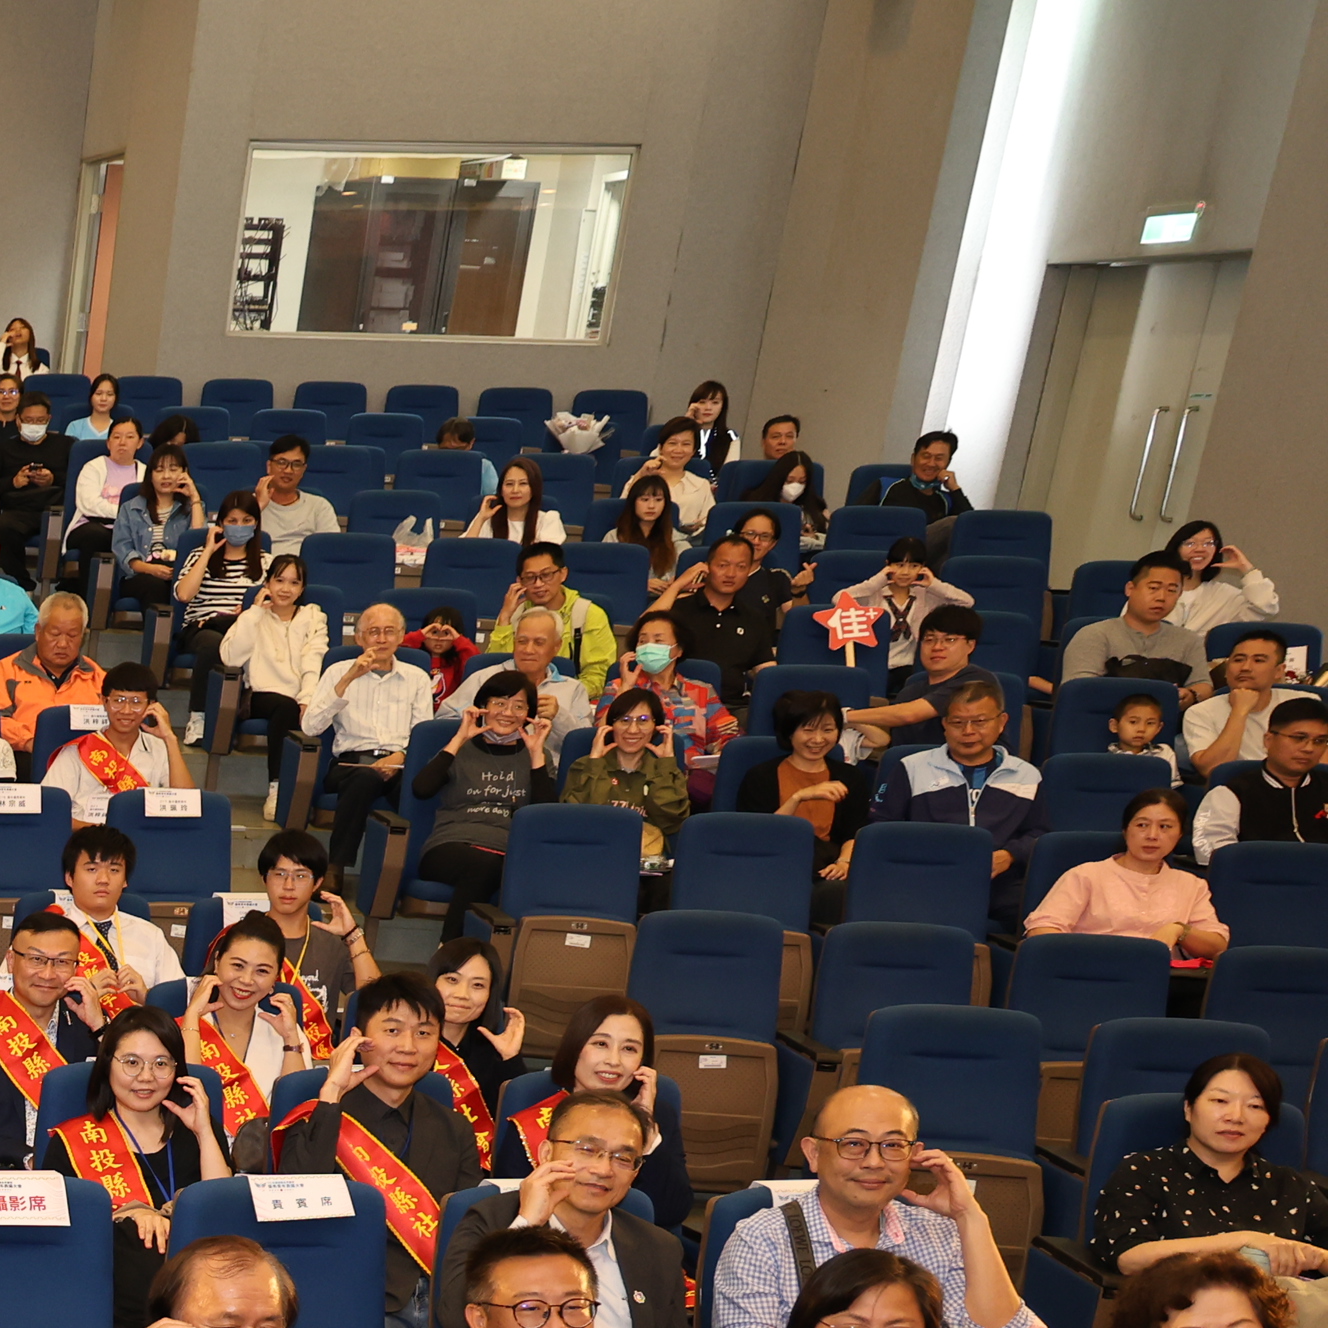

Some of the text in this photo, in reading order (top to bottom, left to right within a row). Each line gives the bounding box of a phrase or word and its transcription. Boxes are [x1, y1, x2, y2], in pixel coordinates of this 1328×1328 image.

[481, 770, 514, 782] Hold
[79, 1119, 129, 1202] 南投縣
[271, 1196, 333, 1210] 貴賓席
